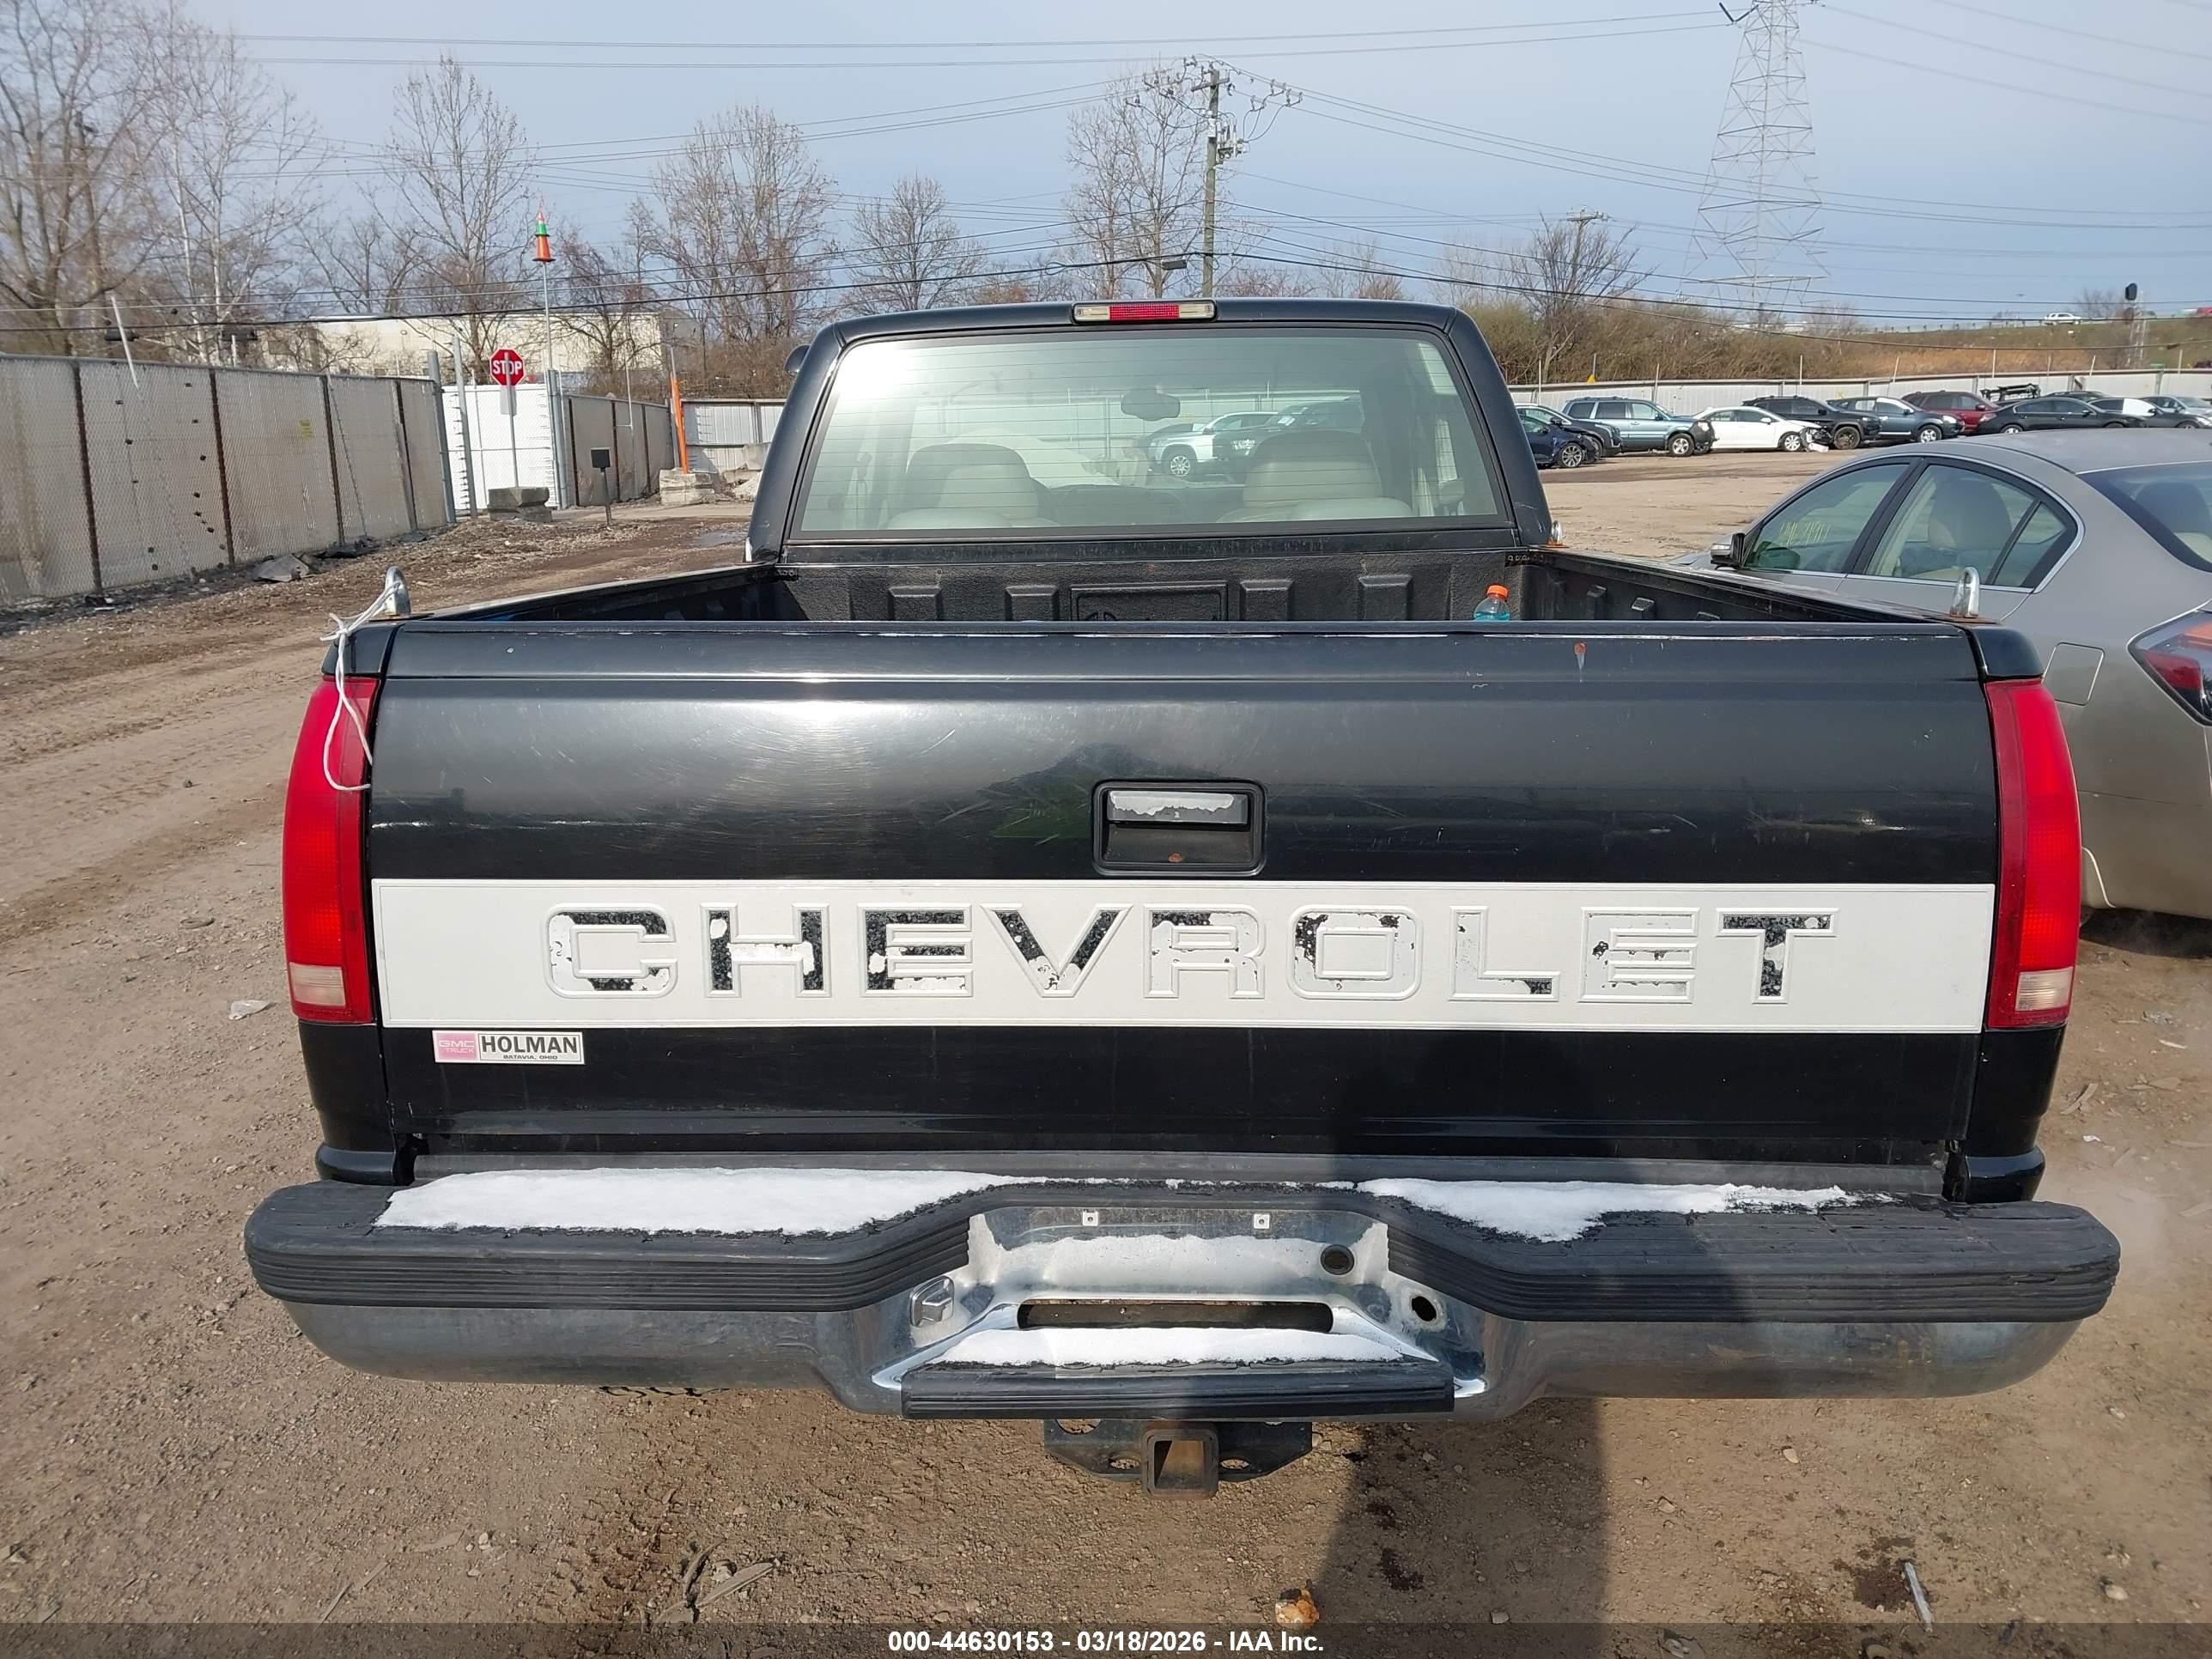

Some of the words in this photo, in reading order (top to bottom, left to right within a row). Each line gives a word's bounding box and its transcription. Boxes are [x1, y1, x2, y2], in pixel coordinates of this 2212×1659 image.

[493, 360, 522, 374] STOP
[543, 902, 1839, 1004] CHEVROLET
[481, 1036, 578, 1054] HOLMAN
